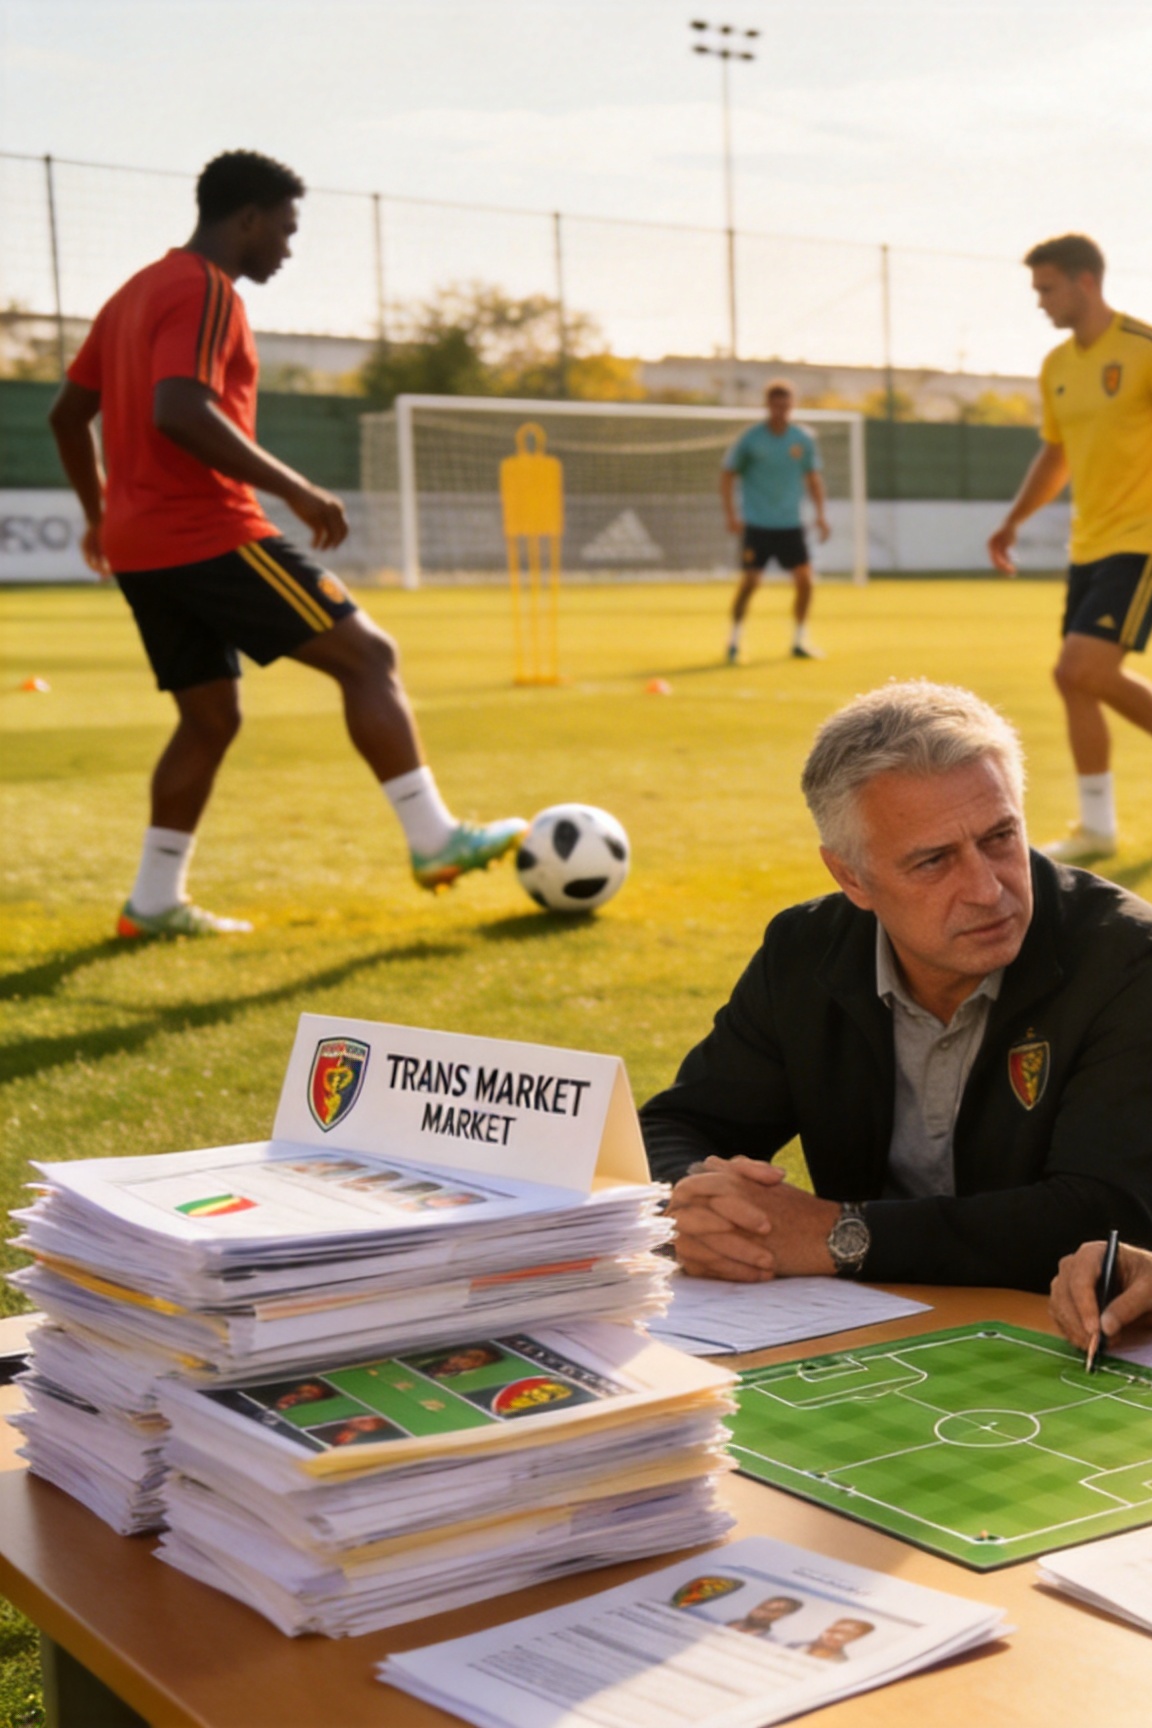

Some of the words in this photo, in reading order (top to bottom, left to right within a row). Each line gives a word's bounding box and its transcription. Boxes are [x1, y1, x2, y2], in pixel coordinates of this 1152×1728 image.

[386, 1053, 470, 1097] TRANS
[474, 1066, 591, 1117] MARKET
[421, 1102, 517, 1146] MARKET
